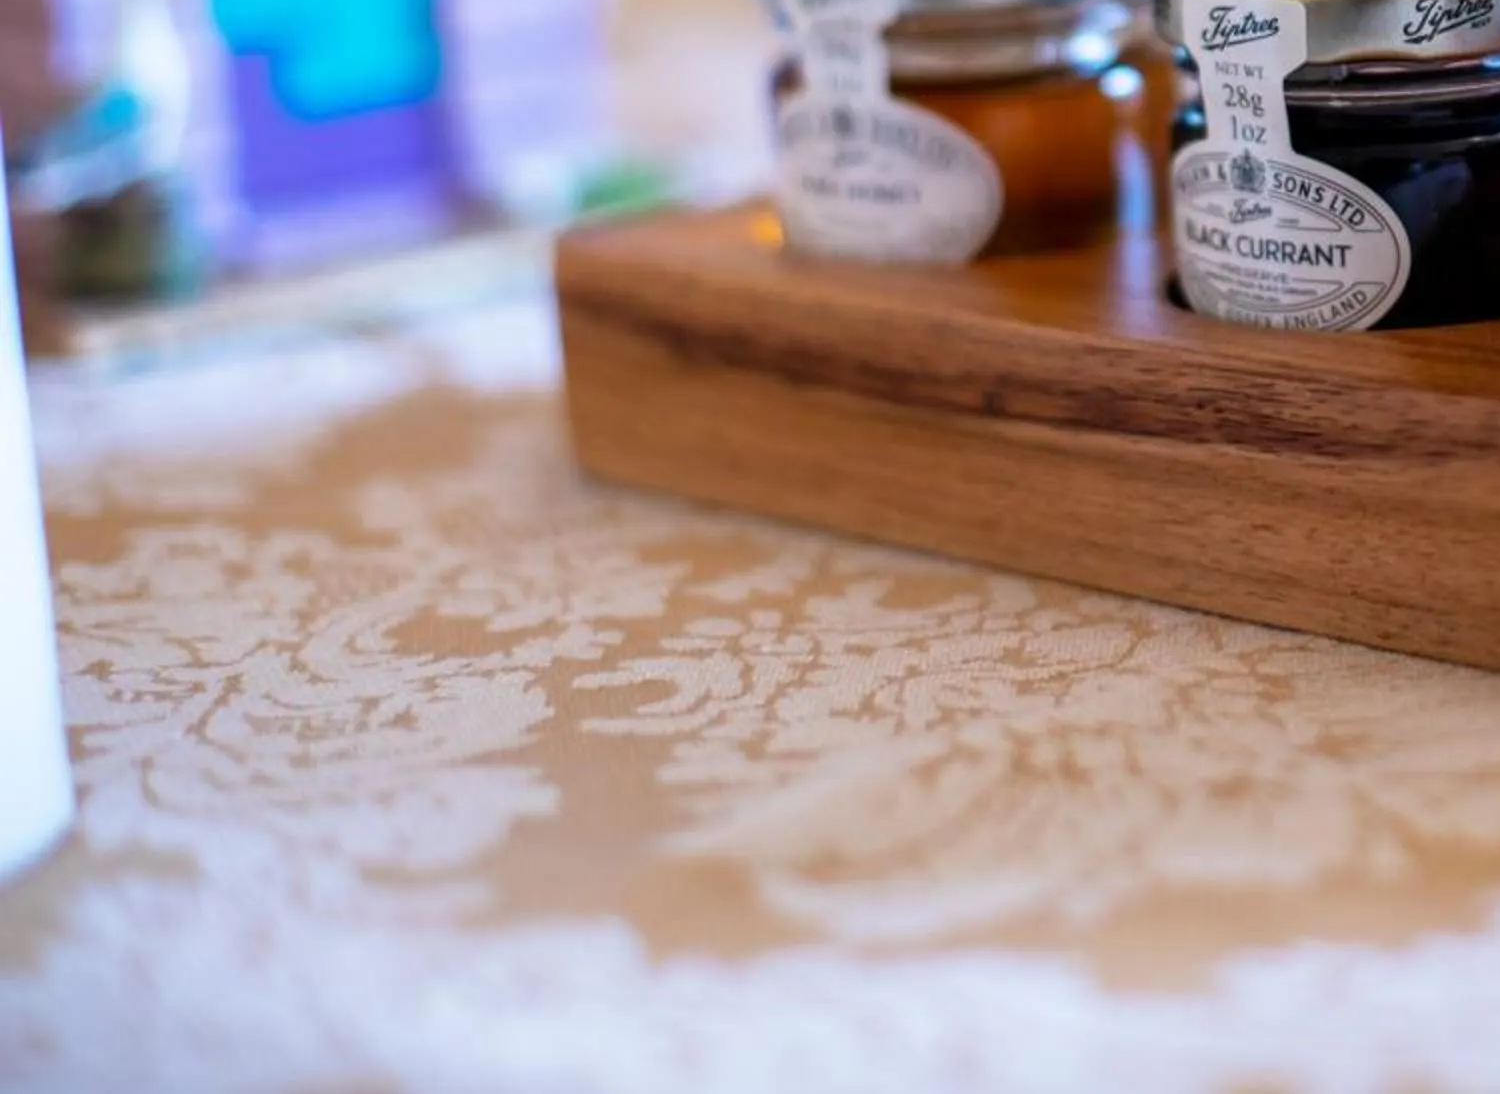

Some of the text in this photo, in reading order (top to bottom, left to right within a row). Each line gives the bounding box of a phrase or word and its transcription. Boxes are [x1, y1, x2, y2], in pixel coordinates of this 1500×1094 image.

[1201, 5, 1280, 51] Tiptree
[1214, 60, 1265, 80] NET WT
[1222, 82, 1266, 118] 28g
[1230, 114, 1268, 145] 1oz
[1272, 171, 1327, 204] SONS
[1328, 193, 1366, 227] LTD
[1235, 234, 1353, 269] CURRANT
[1282, 290, 1368, 330] ENGLAND
